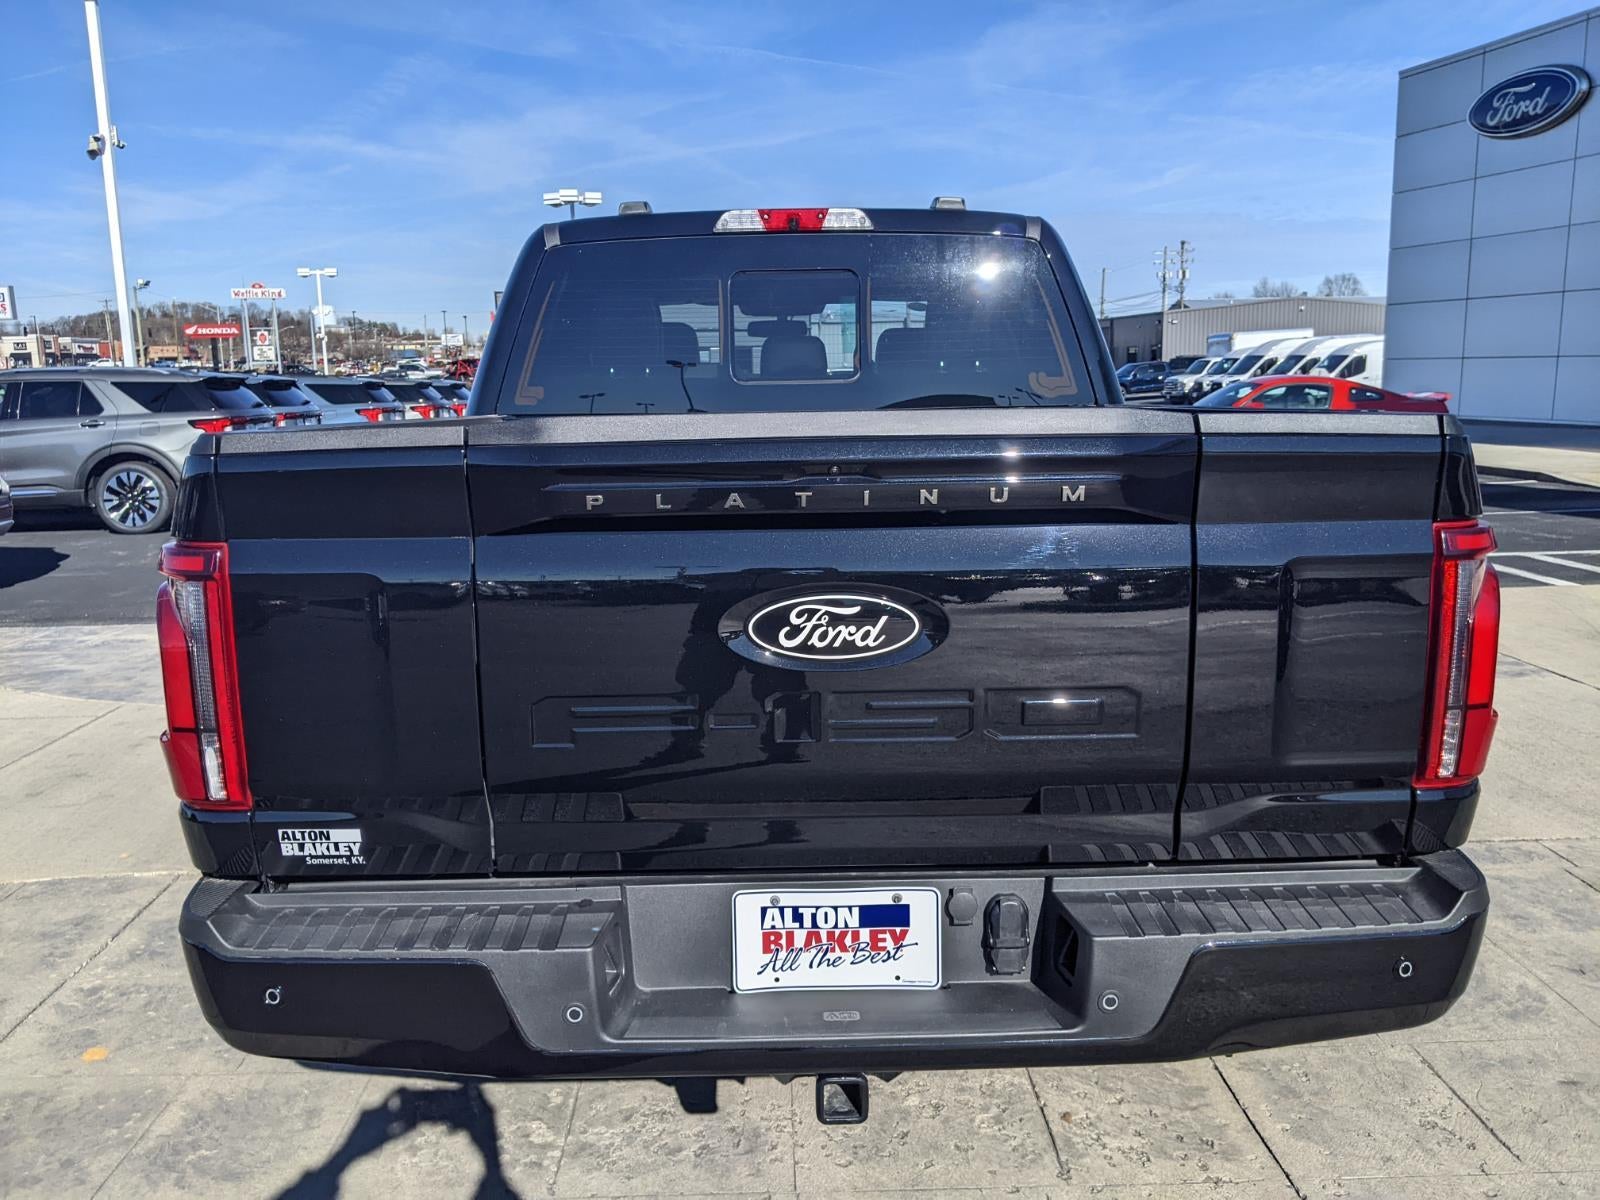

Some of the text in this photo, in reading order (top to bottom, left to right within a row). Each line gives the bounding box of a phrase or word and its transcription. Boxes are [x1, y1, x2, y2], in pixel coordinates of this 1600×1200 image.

[1486, 82, 1551, 126] Ford
[261, 290, 283, 298] King
[197, 327, 240, 335] HONDA
[586, 485, 1087, 511] PLATINUM
[777, 603, 889, 649] Ford
[531, 686, 1140, 749] F-150
[281, 830, 331, 842] ALTON
[280, 842, 361, 857] BLAKLEY
[305, 856, 367, 866] Somerset, KY.
[762, 906, 860, 930] ALTON
[762, 929, 910, 955] BLAKLEY
[757, 941, 919, 976] All The Best
